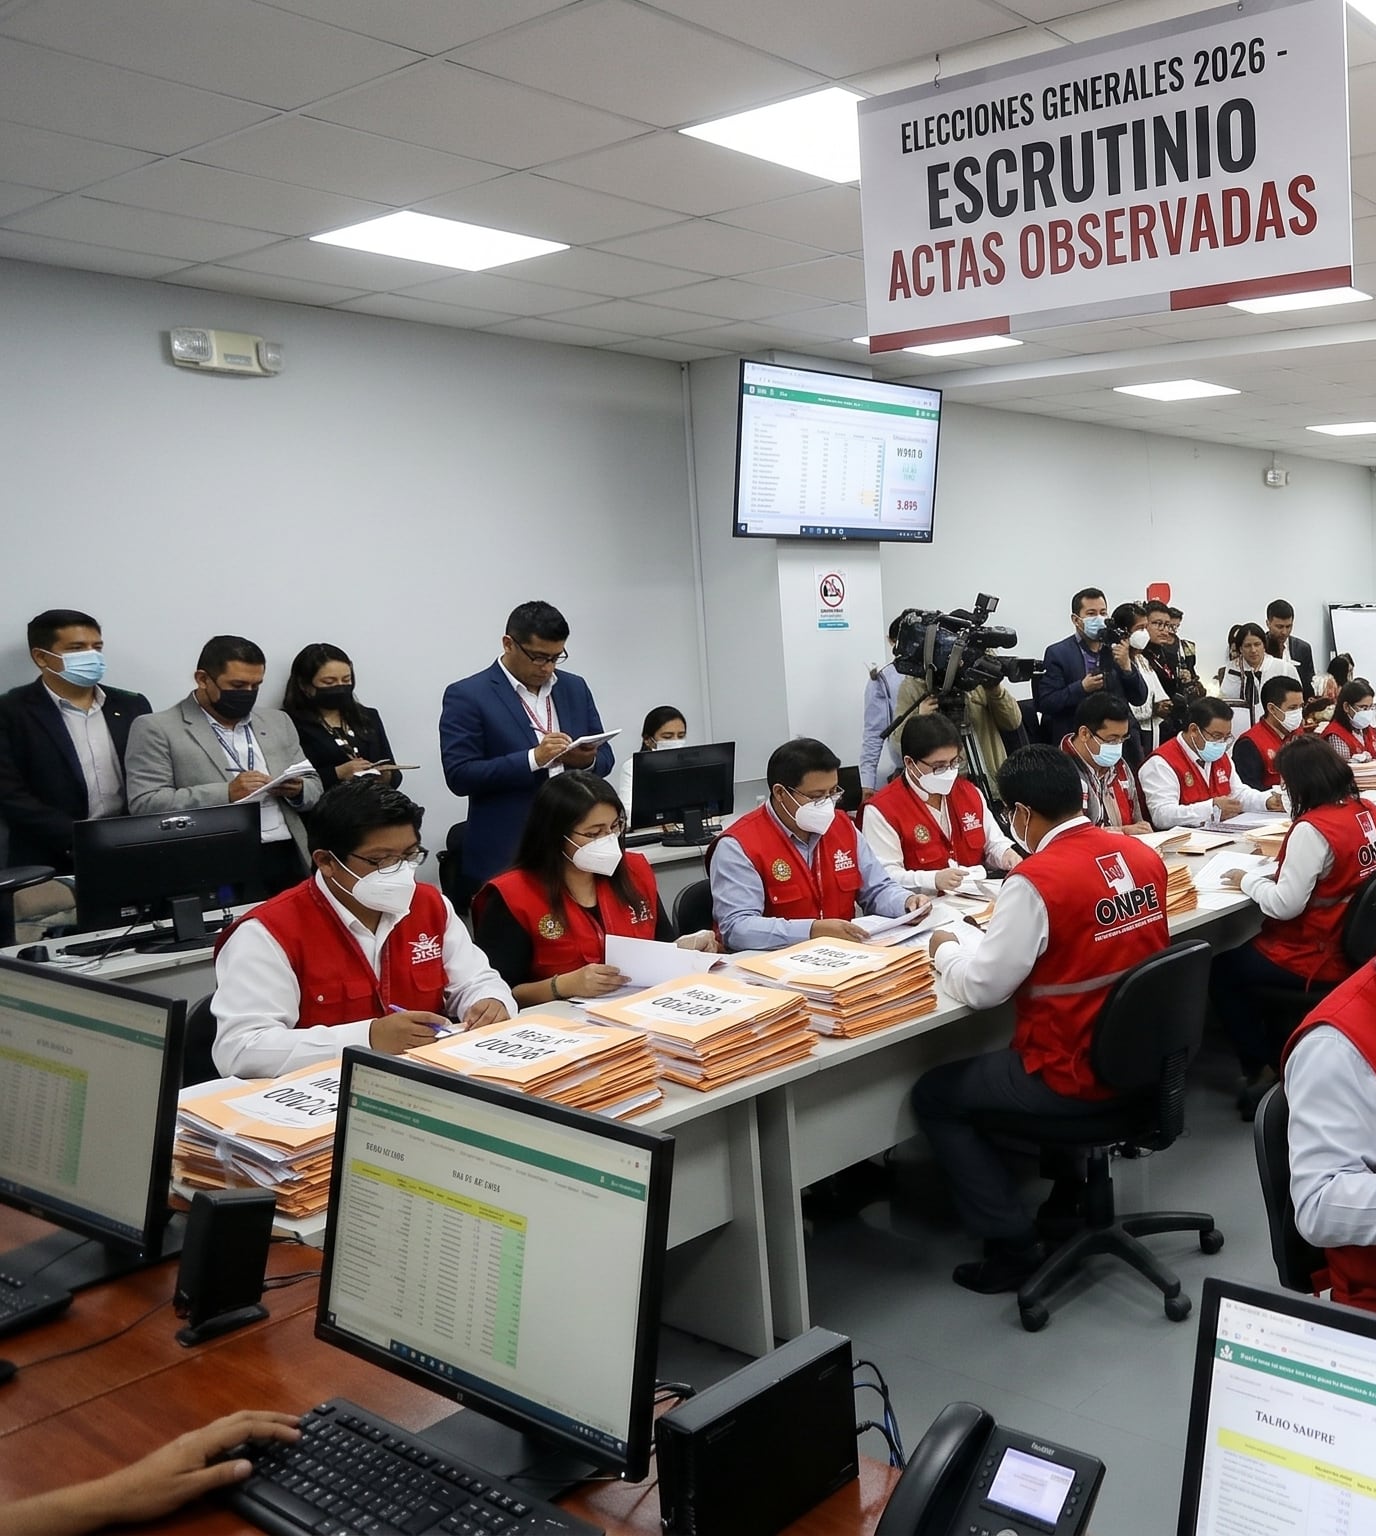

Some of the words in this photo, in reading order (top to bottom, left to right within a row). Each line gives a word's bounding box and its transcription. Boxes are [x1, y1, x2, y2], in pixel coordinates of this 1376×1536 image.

[901, 93, 1034, 154] ELECCIONES
[1042, 56, 1185, 122] GENERALES
[1194, 37, 1266, 88] 2026
[926, 97, 1257, 230] ESCRUTINIO
[888, 231, 1006, 302] ACTAS
[1019, 174, 1318, 280] OBSERVADAS
[1095, 883, 1160, 925] ONPE
